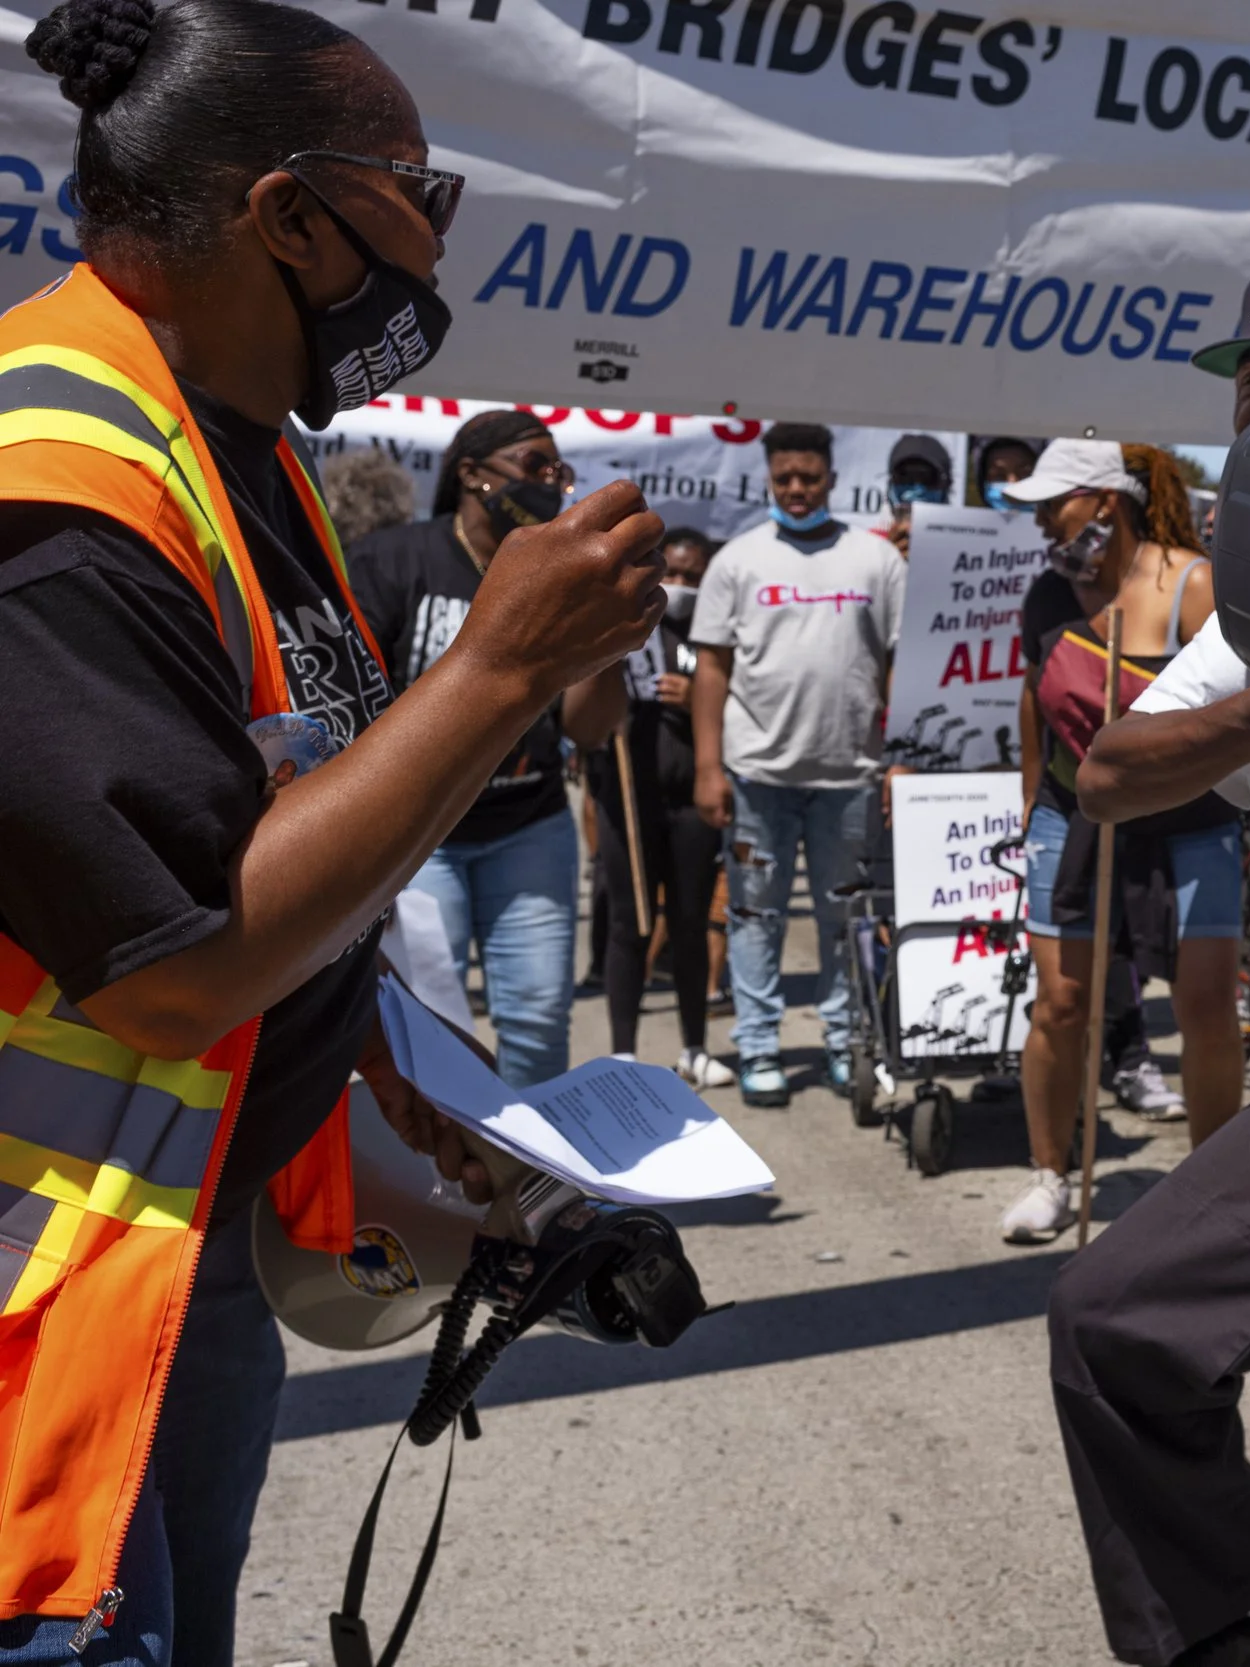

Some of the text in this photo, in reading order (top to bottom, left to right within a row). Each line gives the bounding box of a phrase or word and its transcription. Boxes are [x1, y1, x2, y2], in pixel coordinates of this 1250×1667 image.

[475, 222, 690, 318] AND
[730, 248, 1213, 363] WAREHOUSE
[385, 300, 430, 372] BLACK
[573, 338, 640, 357] MERRILL
[362, 329, 402, 391] LIVES
[330, 348, 372, 413] MATTE
[851, 485, 882, 514] 10
[953, 547, 1048, 572] An Injury
[951, 582, 975, 601] To
[980, 575, 1025, 599] ONE
[929, 612, 960, 633] An
[939, 635, 1026, 688] ALL
[946, 809, 1023, 843] An Inju
[947, 853, 973, 872] To
[931, 876, 1020, 909] An Injur
